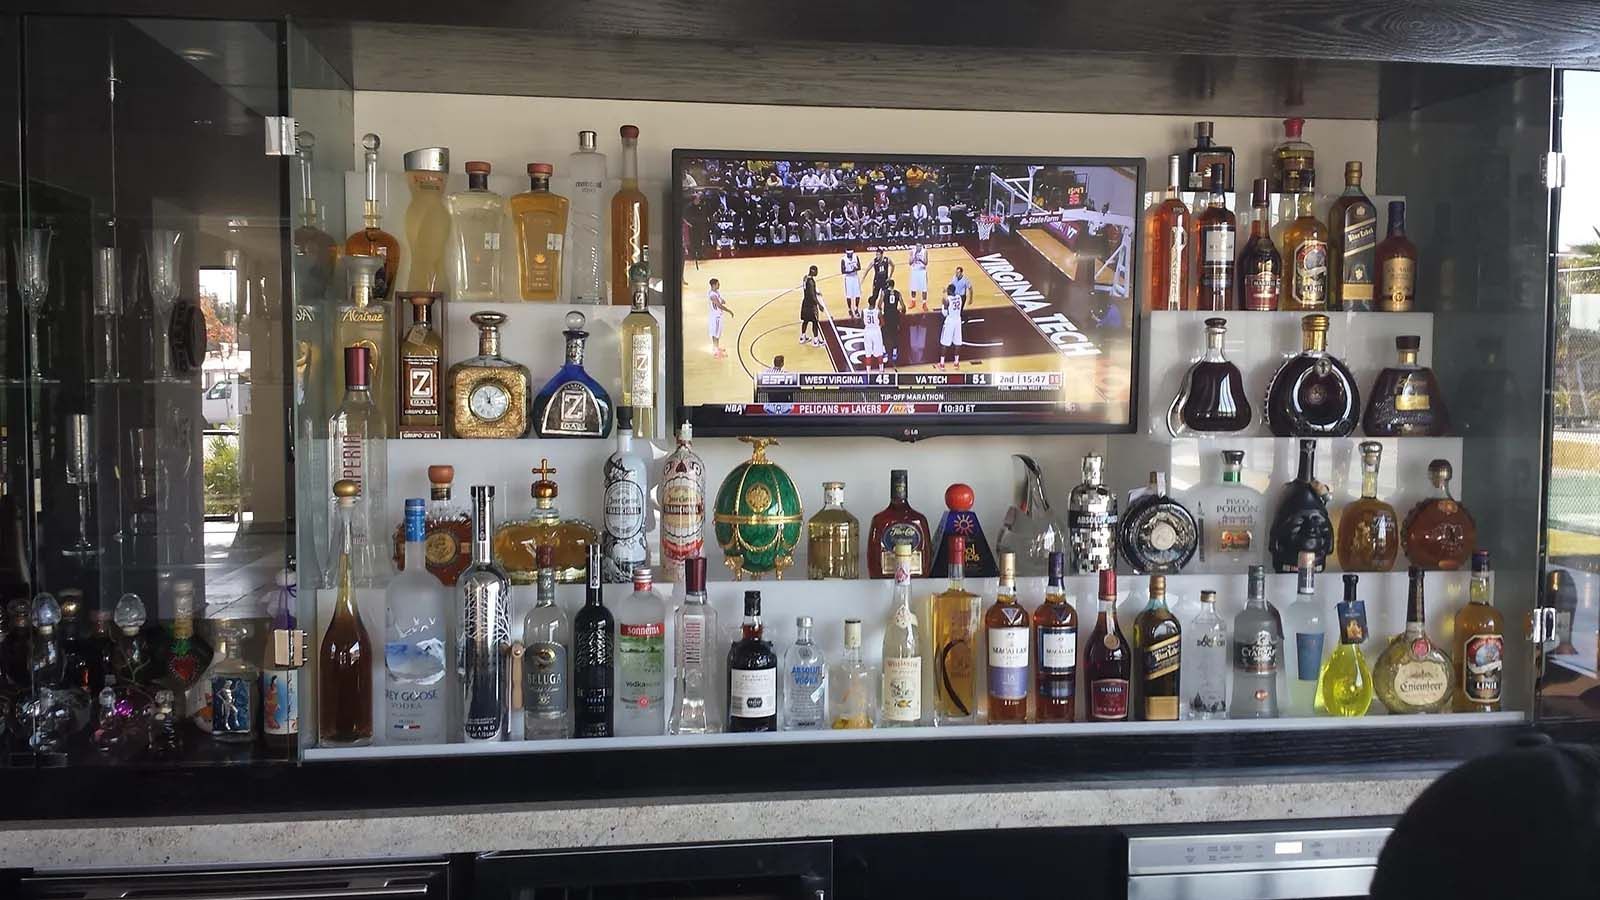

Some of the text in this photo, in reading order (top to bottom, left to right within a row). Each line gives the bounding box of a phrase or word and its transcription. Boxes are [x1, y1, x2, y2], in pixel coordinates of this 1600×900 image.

[976, 252, 1102, 357] VIRGINIA TECH
[412, 371, 431, 396] Z
[762, 375, 794, 385] ESPN
[804, 375, 864, 384] WEST VIRGINIA
[875, 374, 890, 384] 45
[915, 375, 948, 384] VA TECH
[999, 374, 1014, 384] 2nd
[1022, 375, 1046, 384] 15:47
[880, 393, 944, 401] TIP-OFF MARATHON
[565, 394, 584, 419] Z
[724, 404, 882, 415] NBA PELICANS vs LAKERS
[943, 404, 976, 413] 10:30 ET
